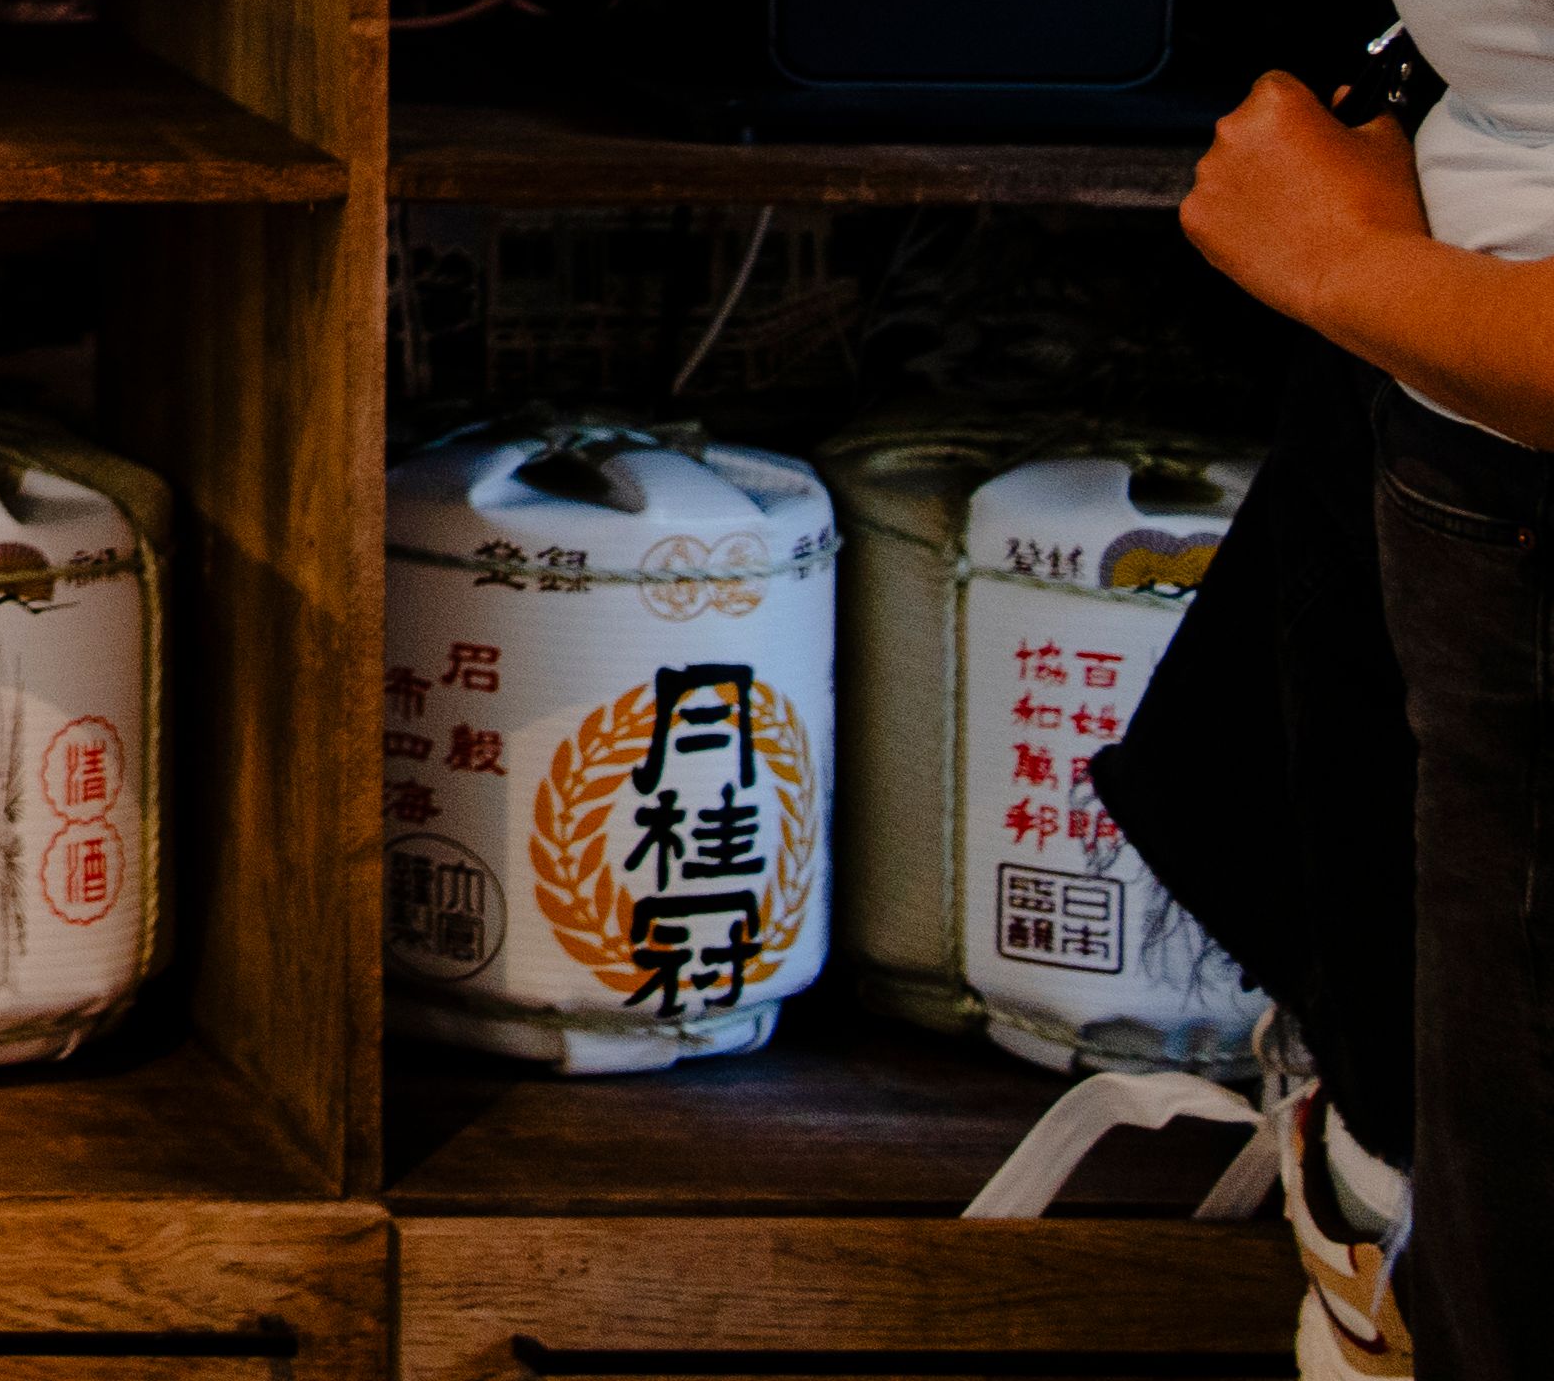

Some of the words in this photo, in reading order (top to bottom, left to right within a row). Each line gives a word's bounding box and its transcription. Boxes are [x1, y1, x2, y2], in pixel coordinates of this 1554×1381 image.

[65, 739, 108, 905] 清酒
[624, 663, 766, 1018] 月桂冠
